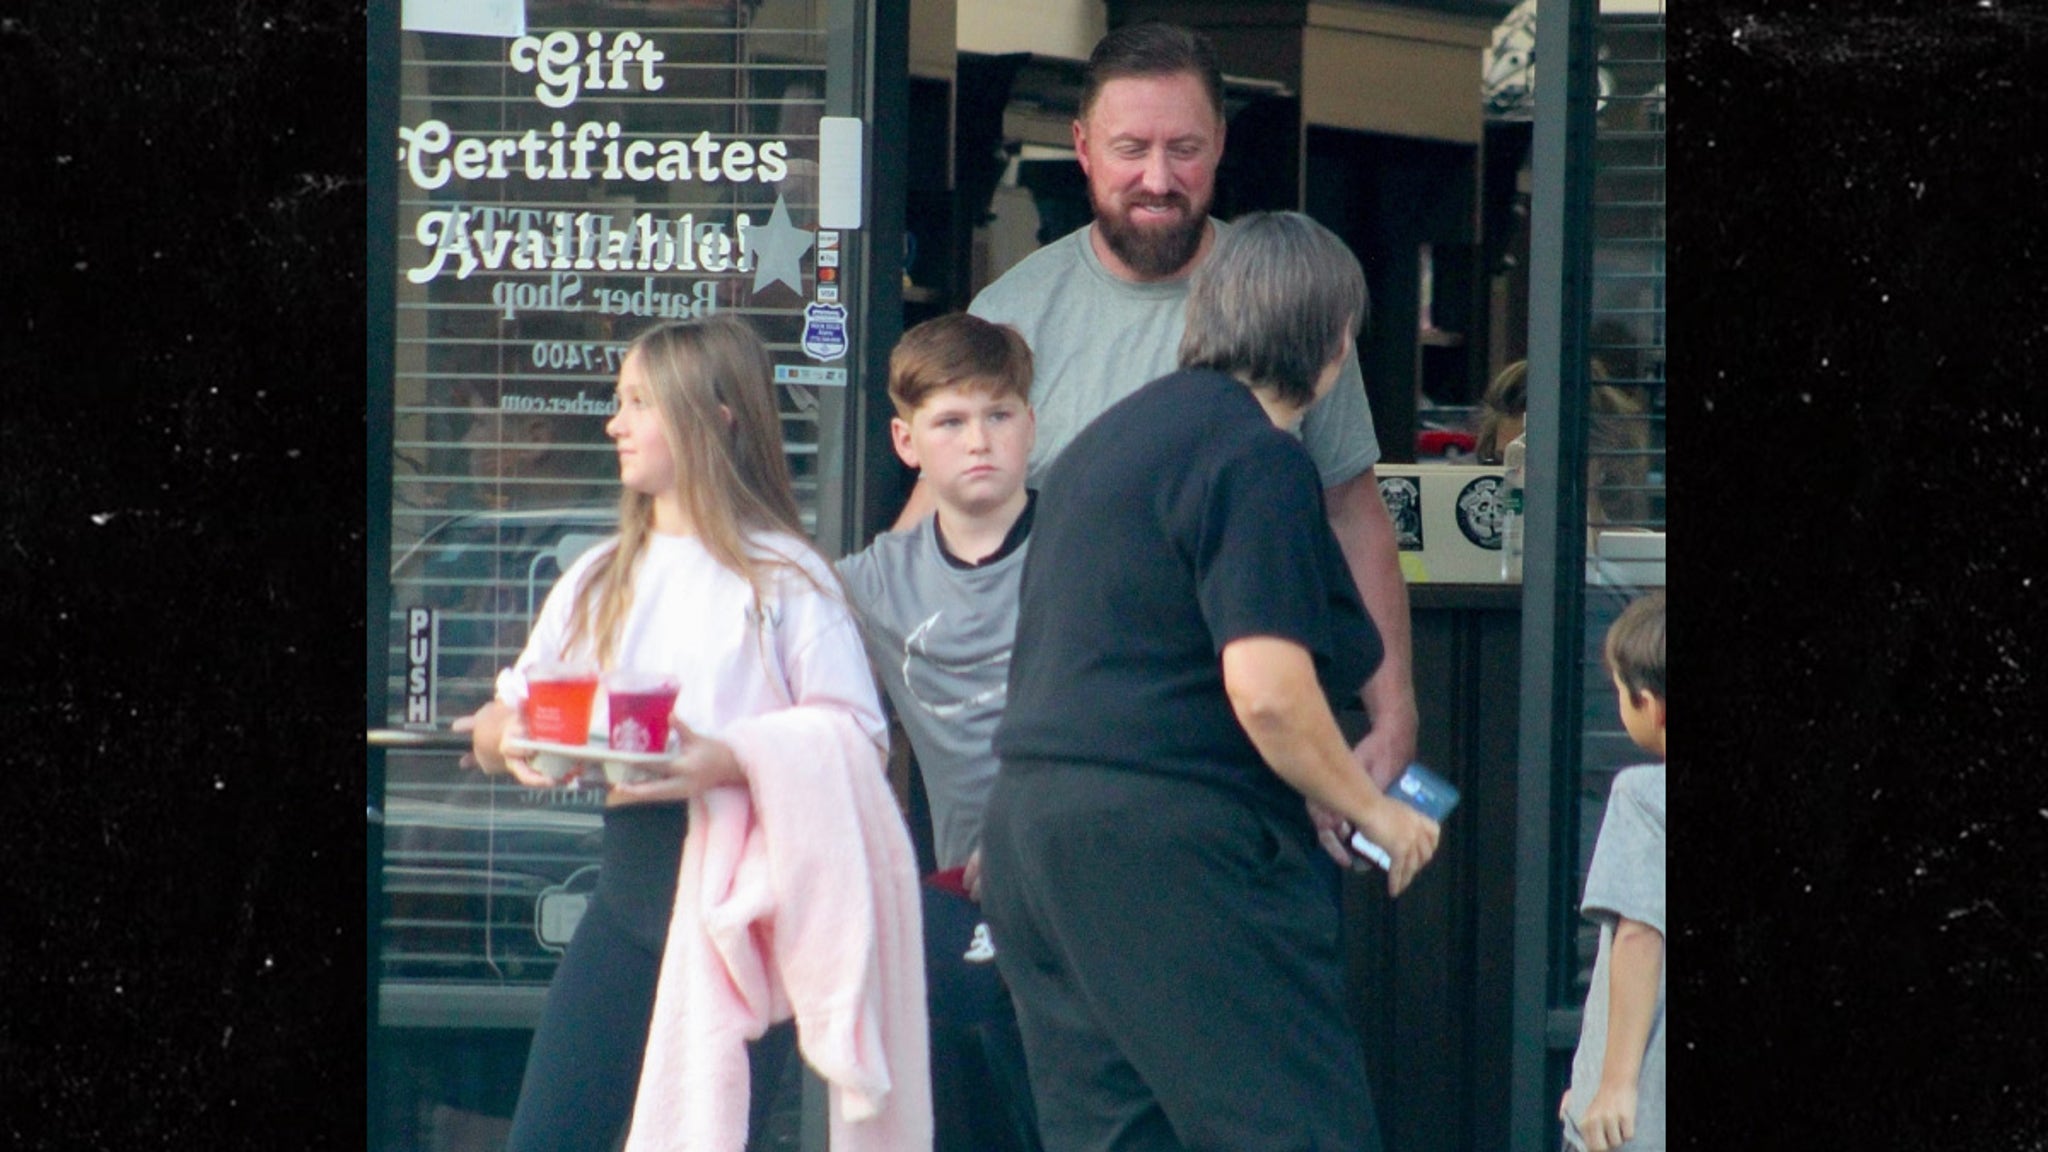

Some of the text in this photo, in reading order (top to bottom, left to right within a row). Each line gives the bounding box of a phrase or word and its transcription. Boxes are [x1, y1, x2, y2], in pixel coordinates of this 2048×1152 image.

[510, 31, 664, 108] Gift
[397, 120, 788, 189] Certificates
[402, 211, 750, 284] Available!
[410, 608, 428, 722] PUSH
